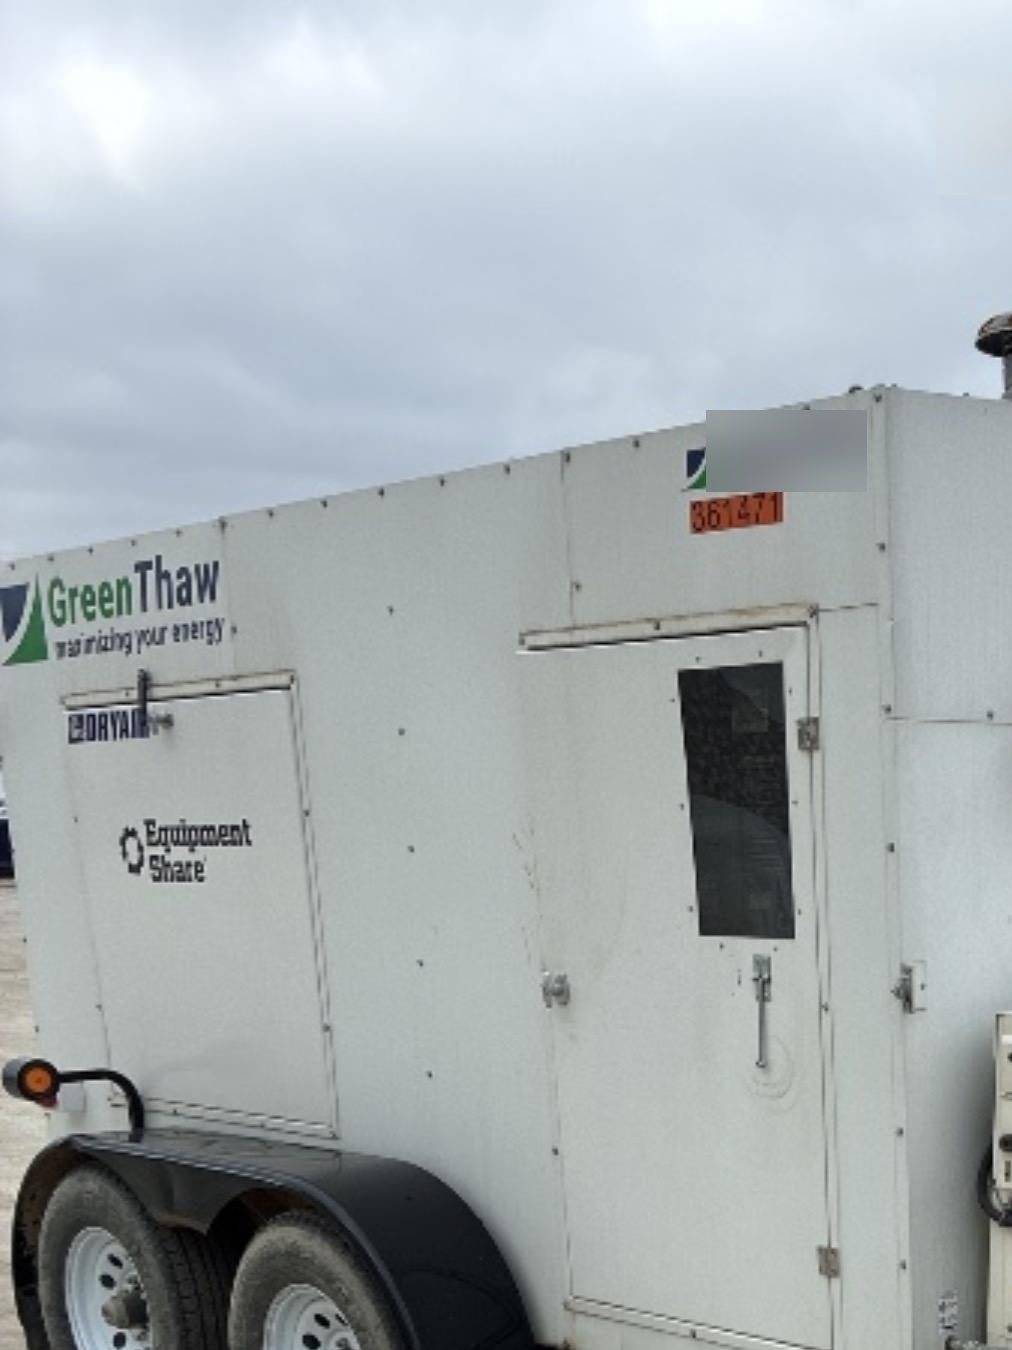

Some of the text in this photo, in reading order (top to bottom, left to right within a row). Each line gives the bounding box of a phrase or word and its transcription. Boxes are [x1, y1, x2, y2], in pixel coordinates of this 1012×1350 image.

[690, 491, 781, 533] 361471
[48, 554, 220, 627] GreenThaw
[134, 625, 169, 655] your
[172, 617, 226, 646] energy
[143, 817, 253, 853] Equipment
[148, 853, 206, 883] Share
